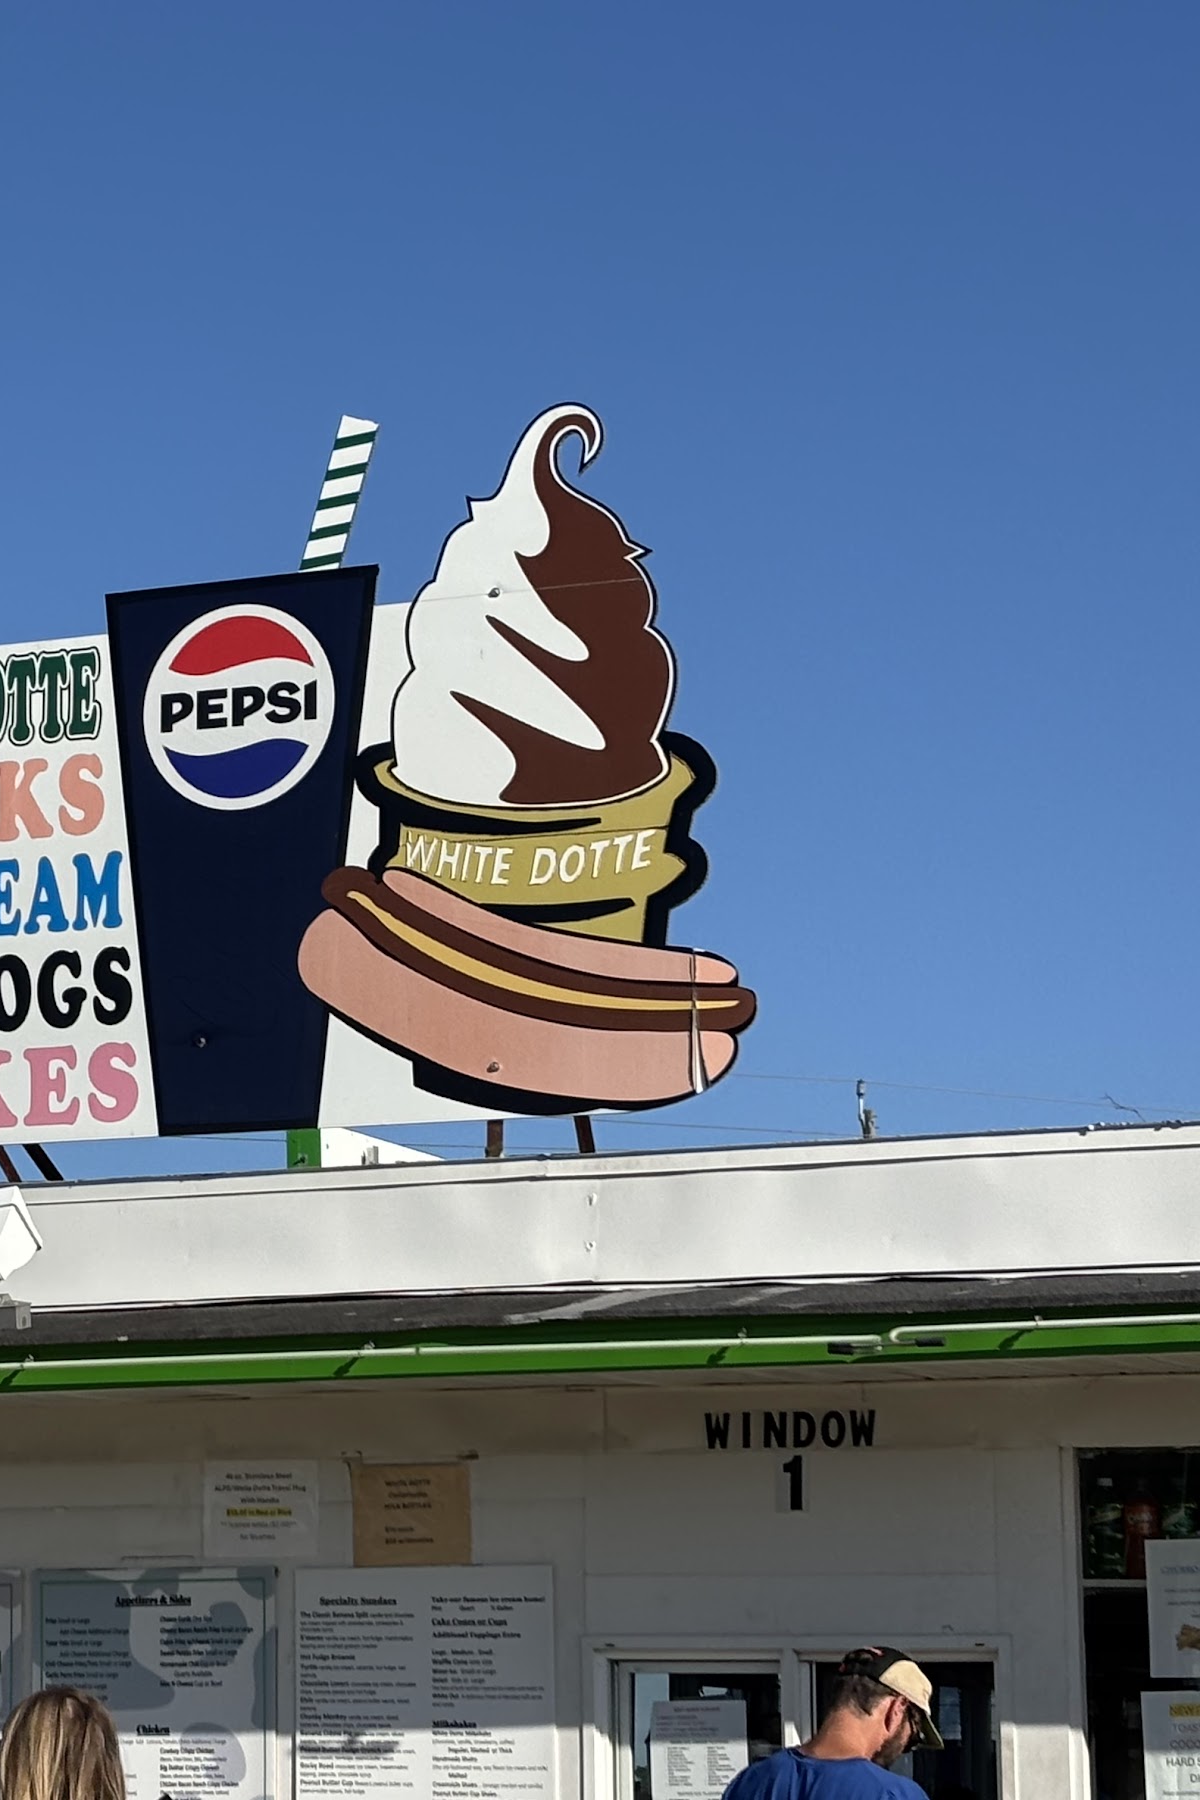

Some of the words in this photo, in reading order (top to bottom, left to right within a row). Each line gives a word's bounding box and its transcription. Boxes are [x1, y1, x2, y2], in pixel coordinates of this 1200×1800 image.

[160, 680, 317, 734] PEPSI
[404, 831, 511, 887] WHITE
[529, 827, 654, 886] DOTTE
[703, 1408, 876, 1450] WINDOW
[782, 1454, 803, 1511] 1
[1166, 1757, 1195, 1767] HARD
